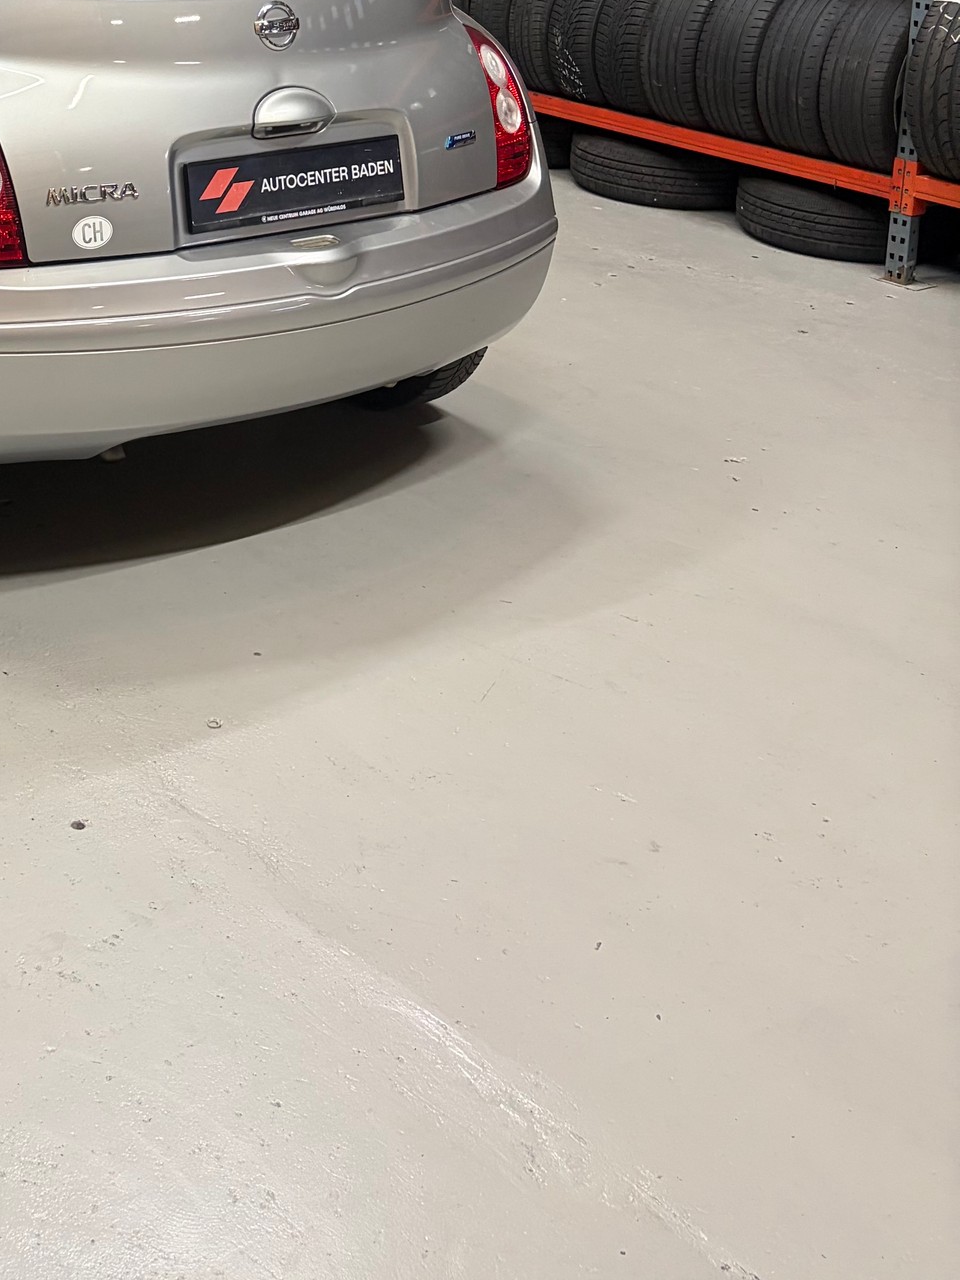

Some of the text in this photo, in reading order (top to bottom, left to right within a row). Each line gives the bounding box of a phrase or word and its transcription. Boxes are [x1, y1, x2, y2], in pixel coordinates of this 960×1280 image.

[260, 159, 394, 193] AUTOCENTER BADEN
[46, 182, 139, 206] MICRA
[299, 208, 317, 217] GARAGE
[81, 220, 104, 244] CH
